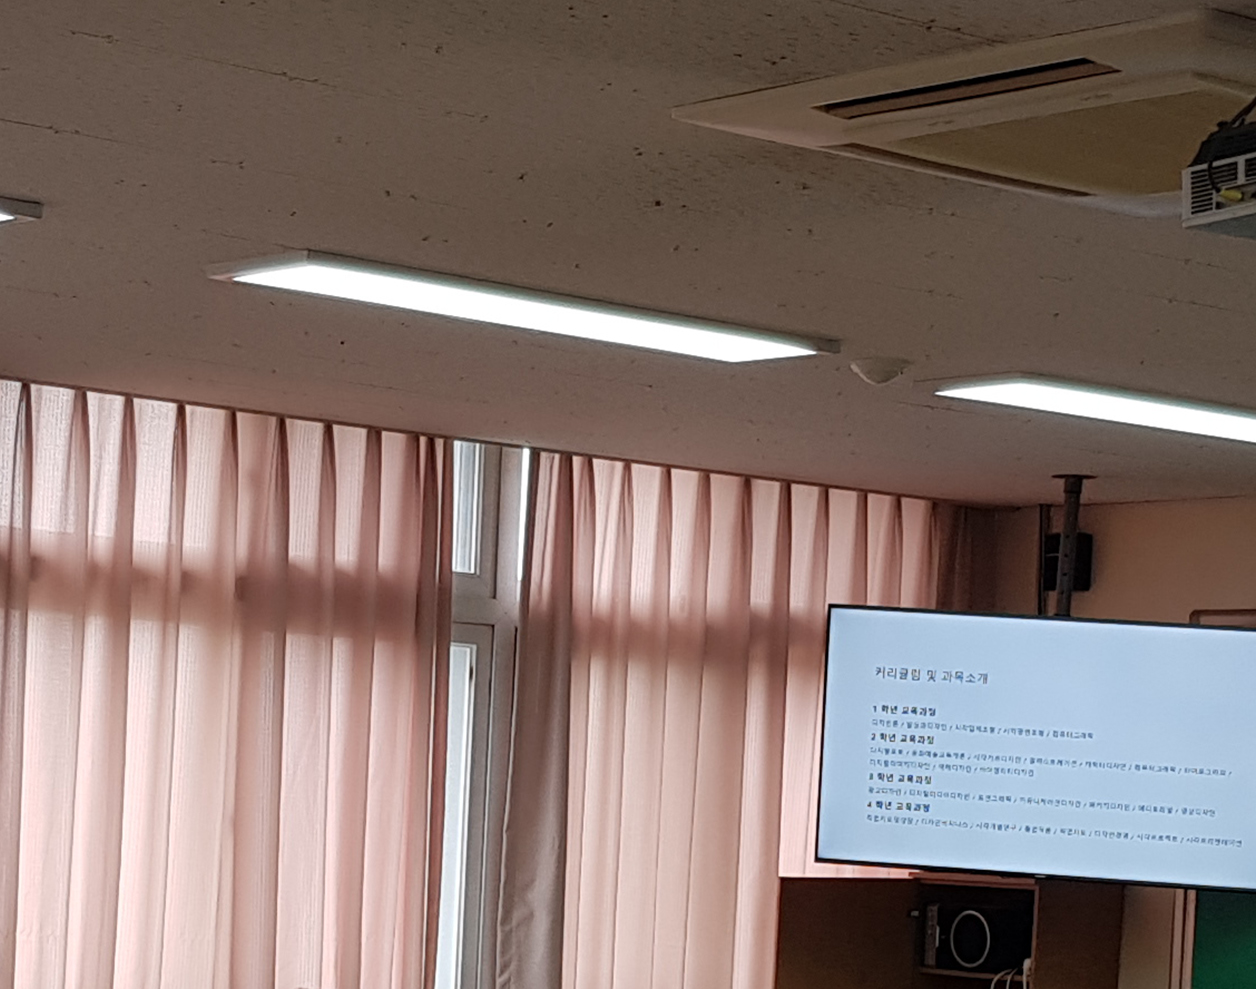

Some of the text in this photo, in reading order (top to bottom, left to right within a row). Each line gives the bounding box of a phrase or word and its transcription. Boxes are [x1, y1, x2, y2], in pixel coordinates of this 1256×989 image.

[926, 669, 936, 682] 및
[941, 670, 988, 684] 과목소개
[881, 704, 898, 714] 학년
[901, 706, 936, 716] 교육과정
[870, 732, 934, 744] 2 학년 교육과정
[876, 772, 893, 782] 학년
[897, 774, 931, 784] 교육과정
[875, 800, 892, 810] 학년
[895, 801, 930, 812] 교육과정
